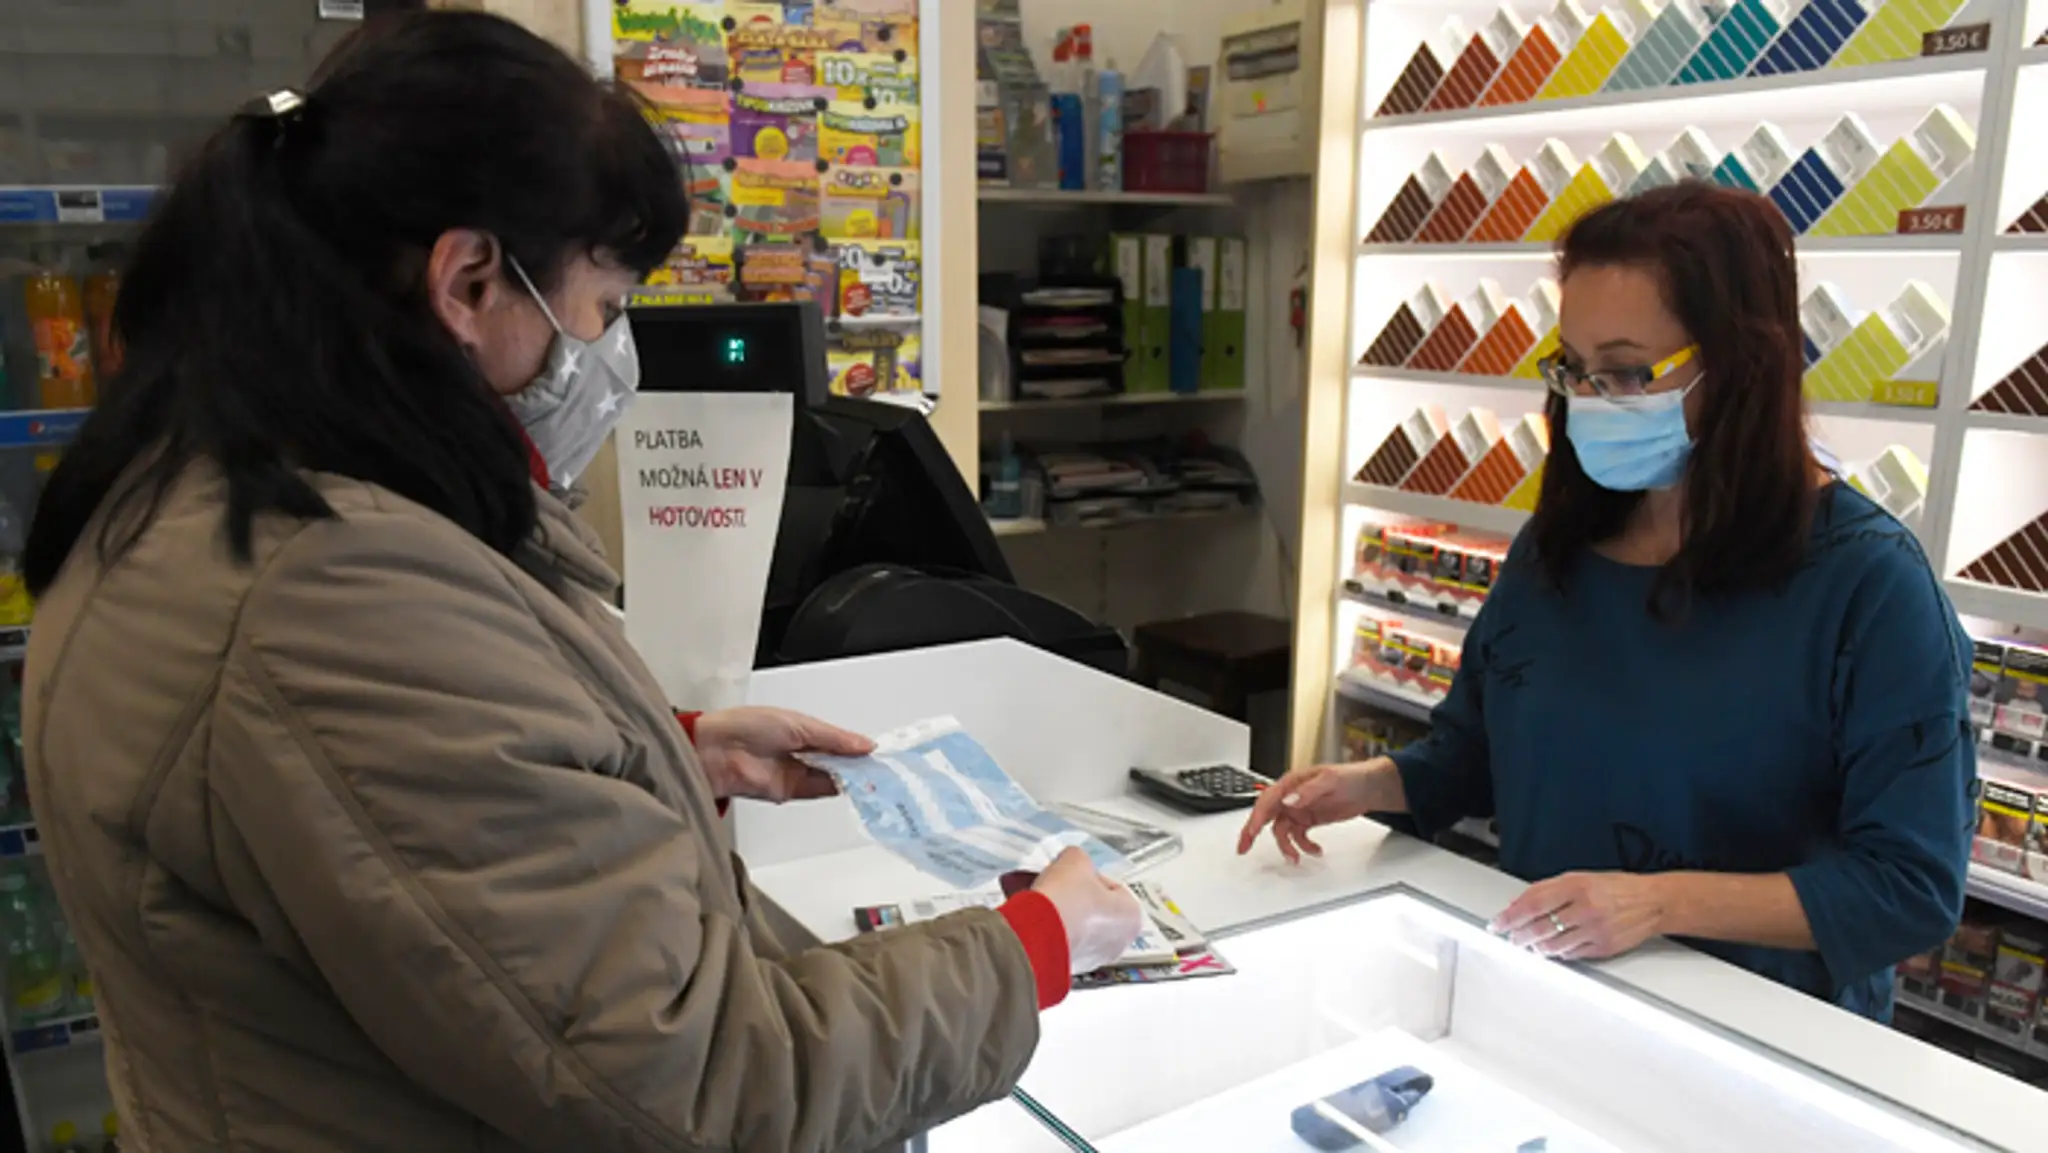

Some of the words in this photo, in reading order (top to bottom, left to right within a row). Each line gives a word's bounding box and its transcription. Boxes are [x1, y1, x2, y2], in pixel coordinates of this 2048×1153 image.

[632, 293, 714, 305] ZNAMENIA
[634, 430, 703, 449] PLATBA
[638, 463, 709, 489] MOŽNÁ
[711, 467, 746, 490] LEN
[750, 468, 762, 489] V
